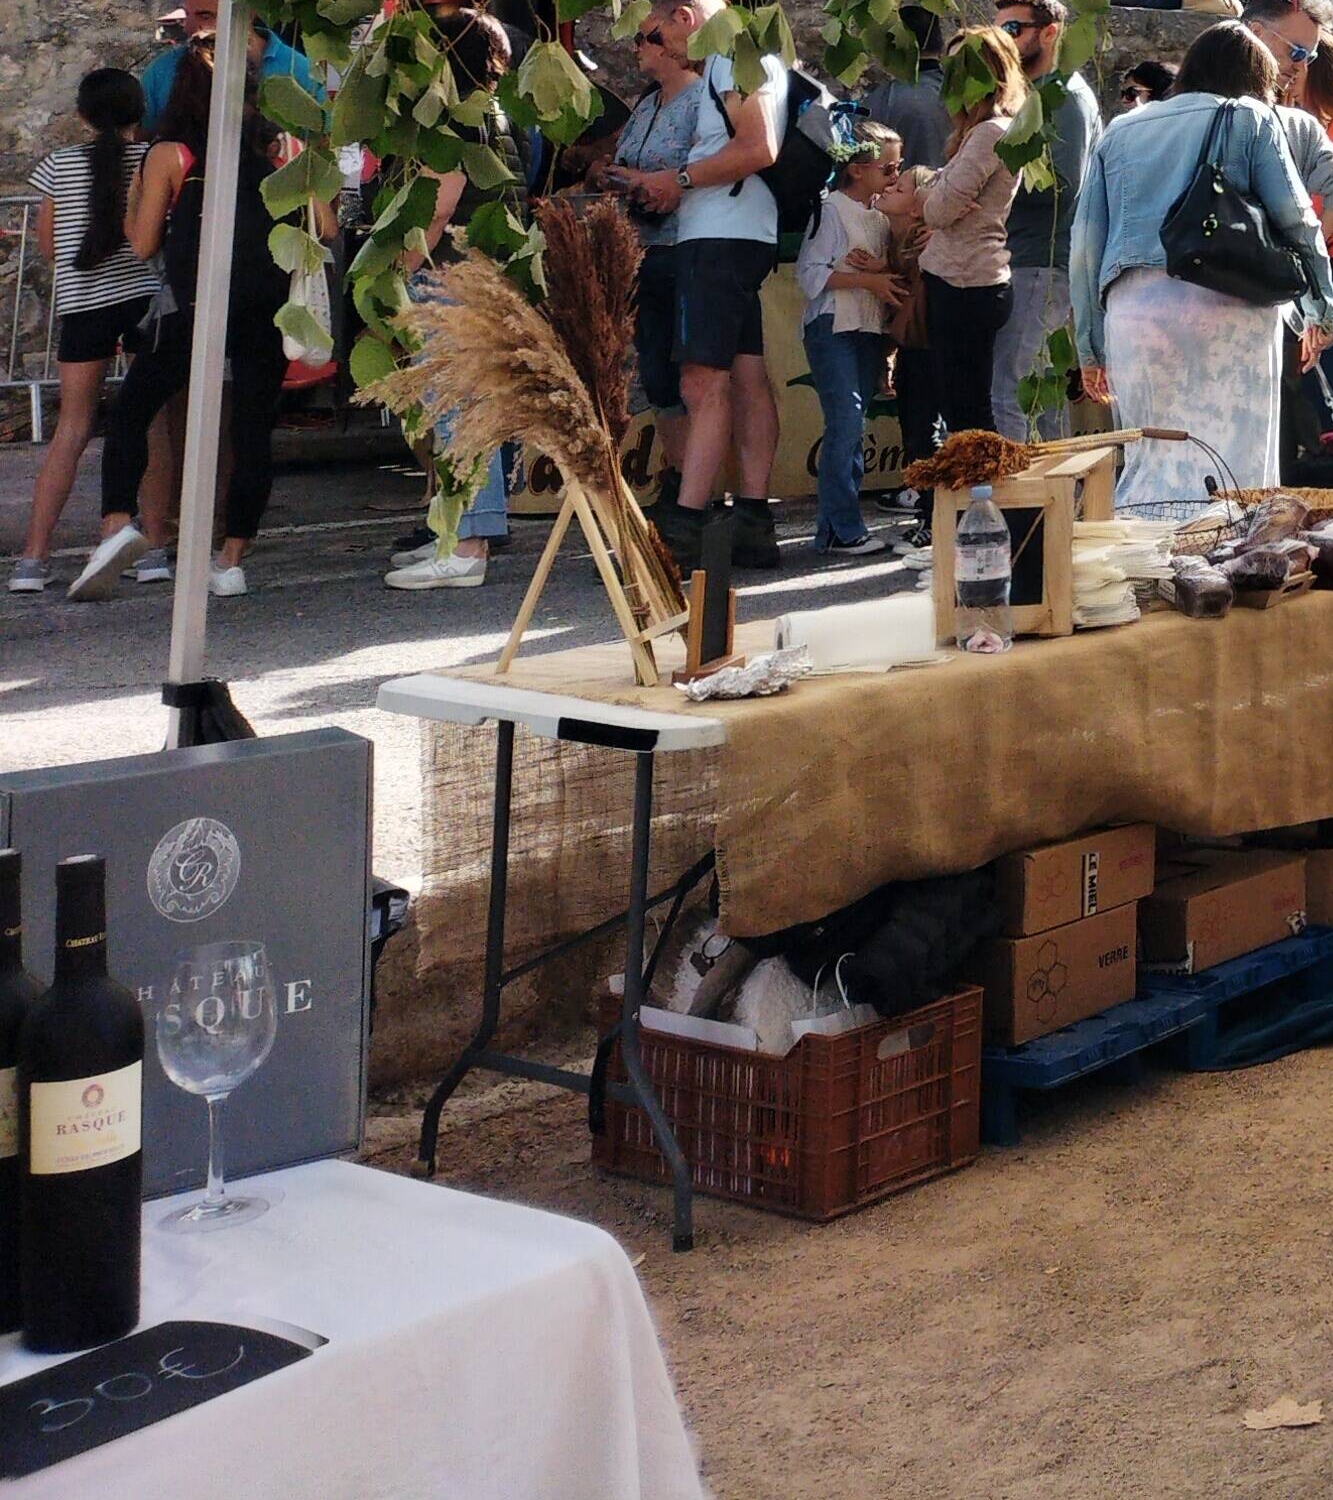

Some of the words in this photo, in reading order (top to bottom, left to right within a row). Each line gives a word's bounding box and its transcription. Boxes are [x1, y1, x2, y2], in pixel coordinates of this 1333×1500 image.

[1098, 944, 1129, 968] VERRE
[158, 979, 313, 1035] SQUE
[56, 1109, 128, 1136] RASQUE
